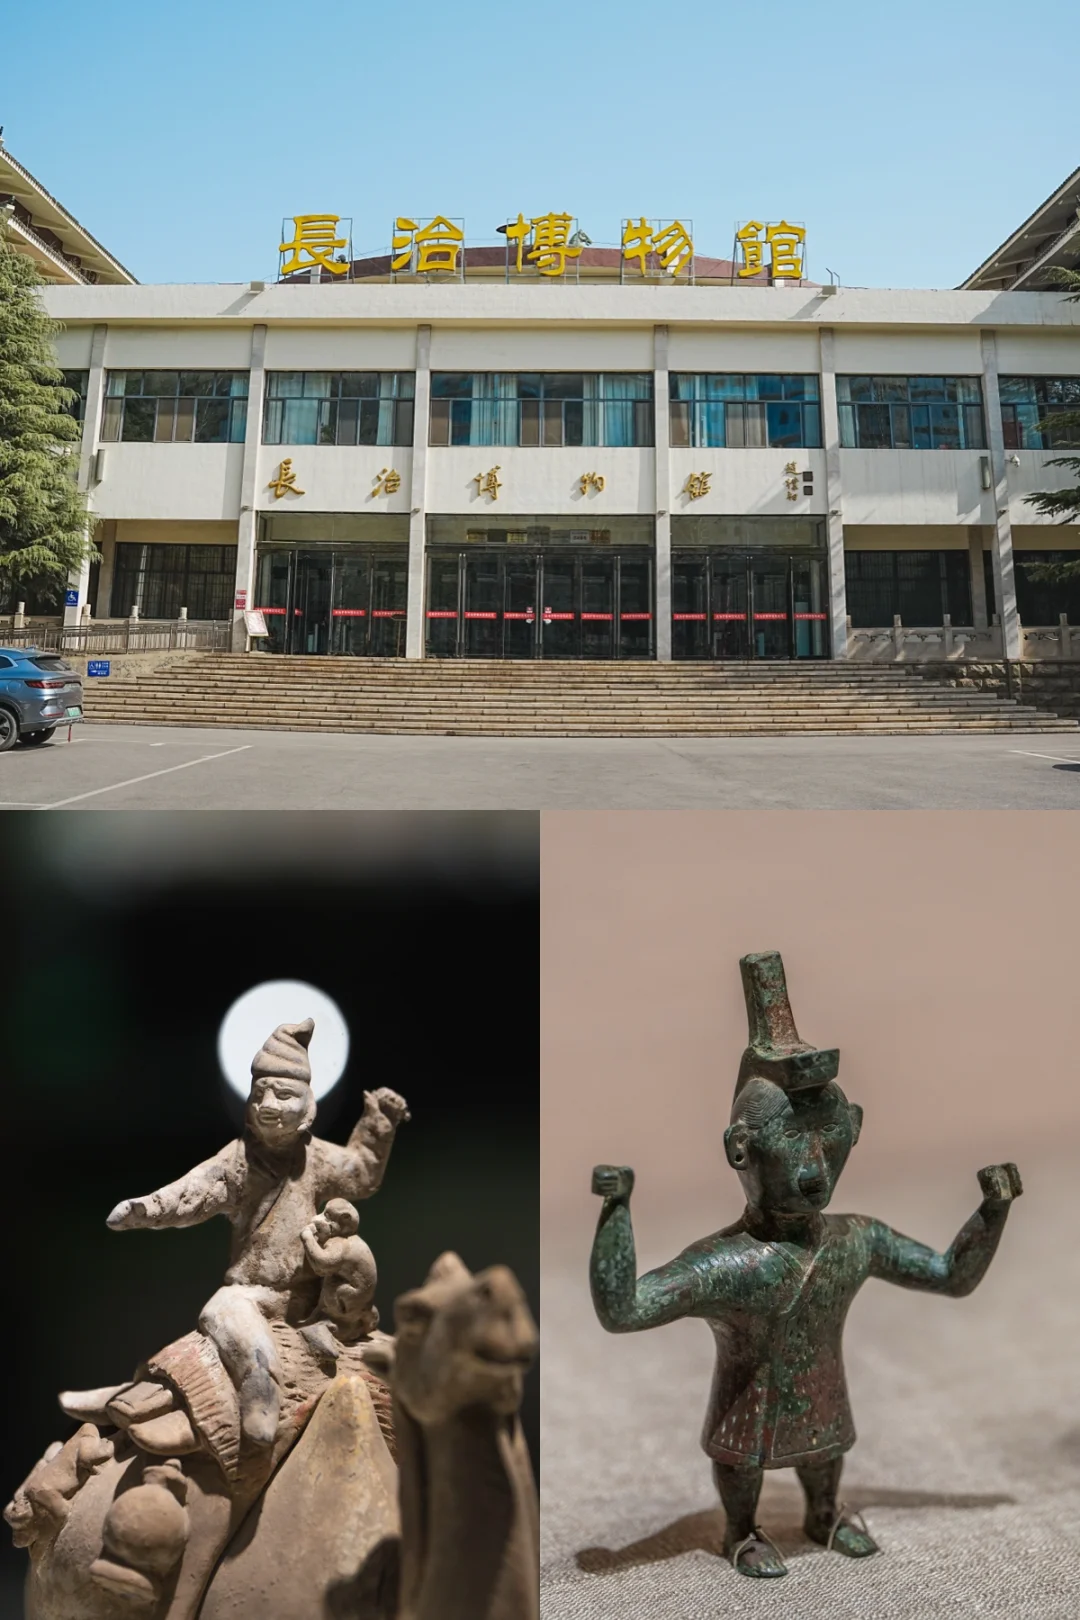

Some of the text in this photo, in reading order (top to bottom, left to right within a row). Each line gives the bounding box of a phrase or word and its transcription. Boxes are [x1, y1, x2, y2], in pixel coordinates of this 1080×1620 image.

[279, 212, 806, 279] 長治博物館
